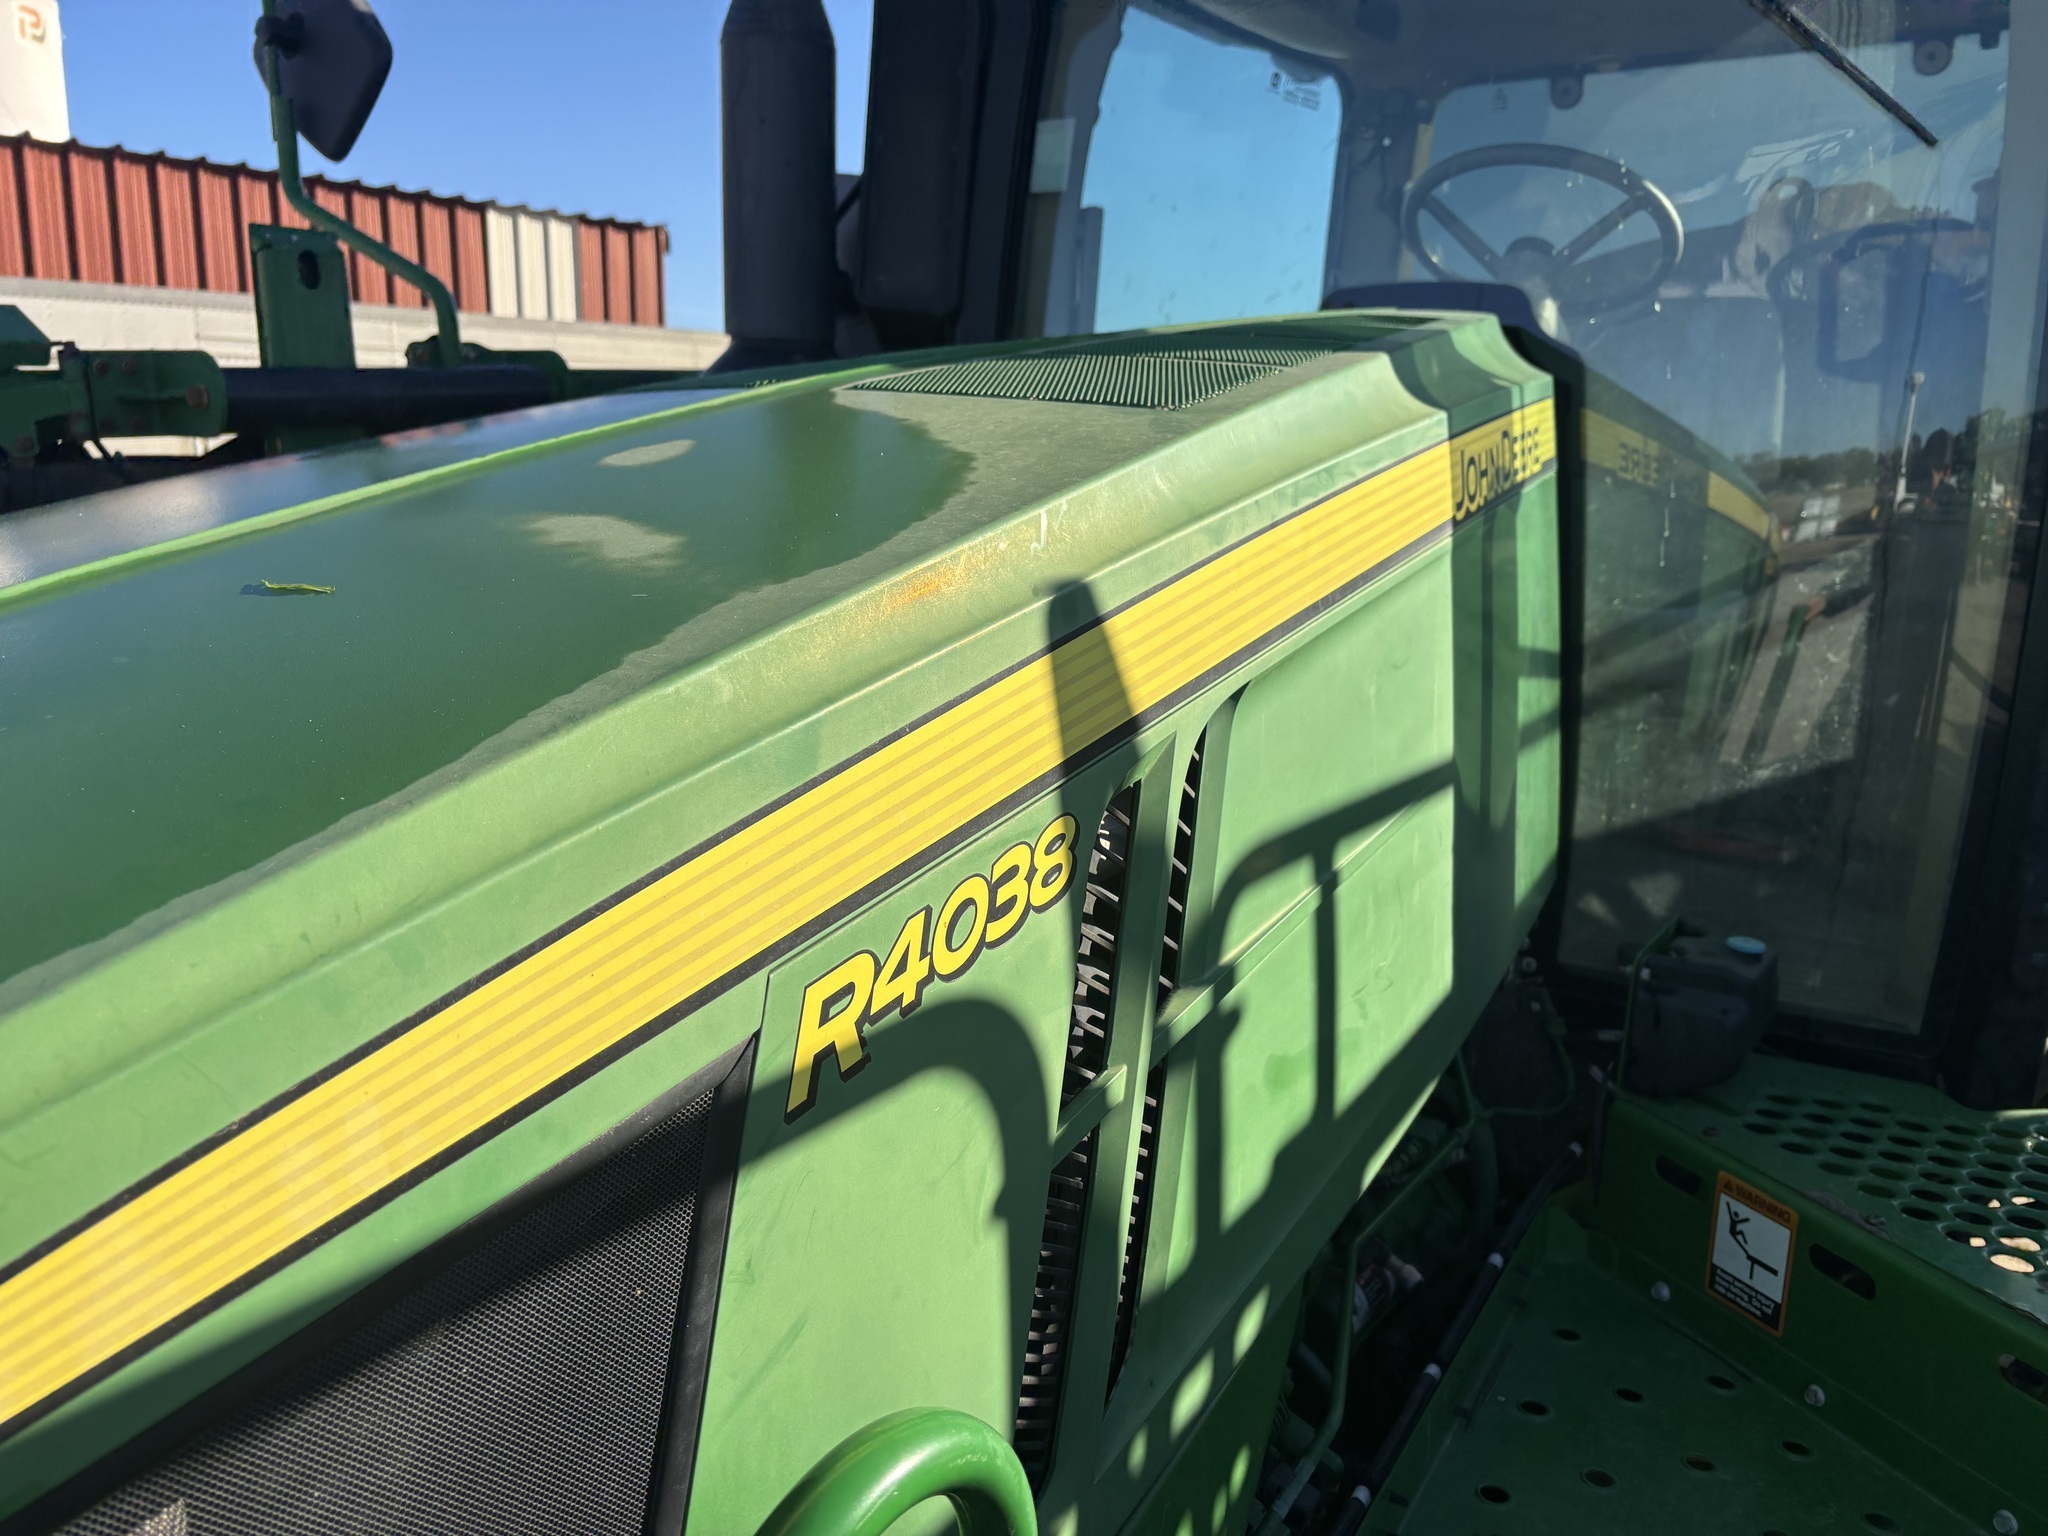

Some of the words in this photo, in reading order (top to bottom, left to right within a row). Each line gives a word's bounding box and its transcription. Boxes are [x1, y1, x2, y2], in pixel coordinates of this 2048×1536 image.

[1454, 443, 1501, 519] JOHN
[1501, 427, 1541, 487] DEERE
[784, 812, 1079, 1125] R4038
[1736, 1184, 1791, 1224] WARNING
